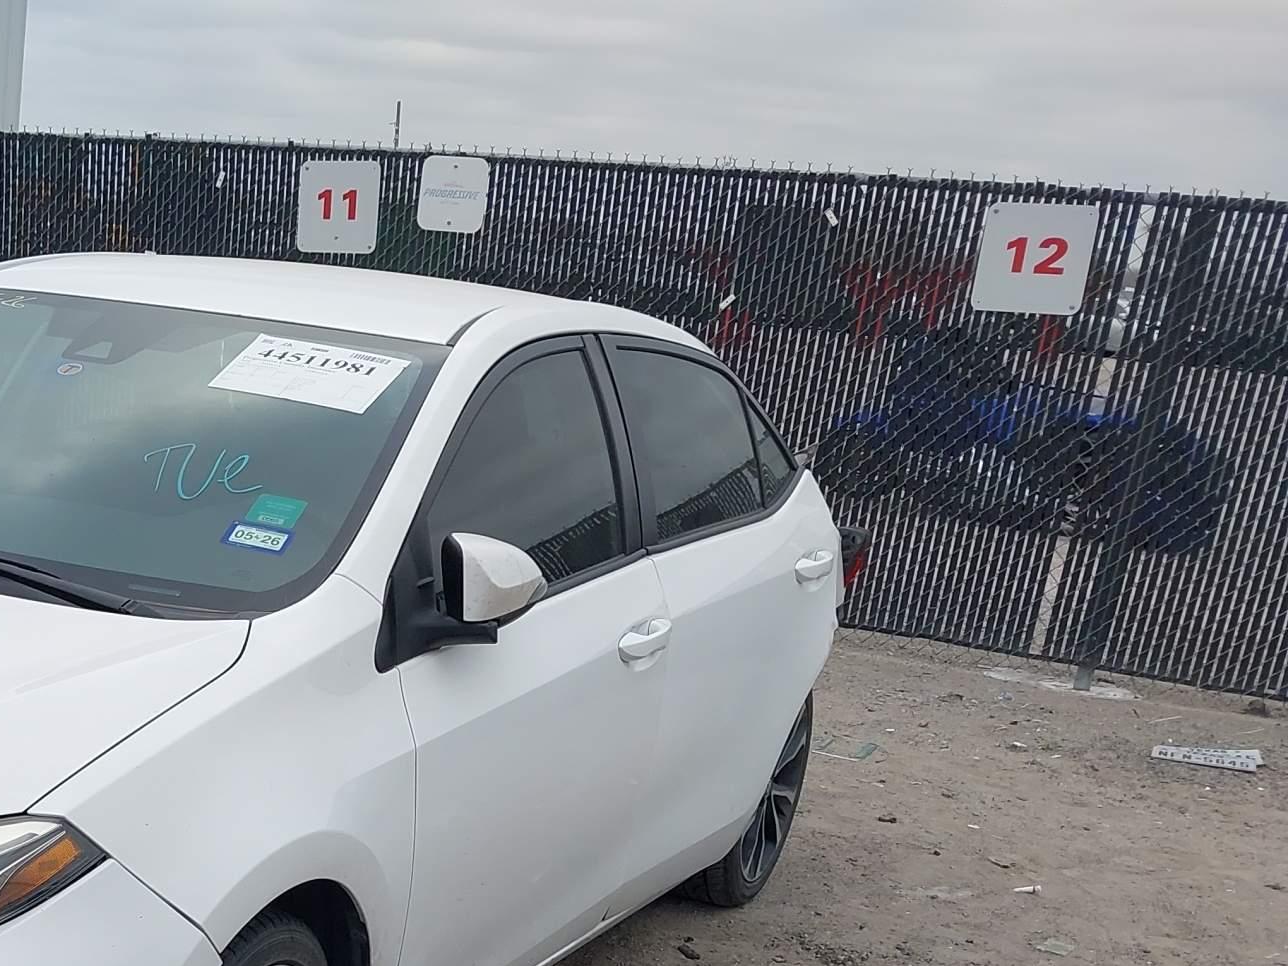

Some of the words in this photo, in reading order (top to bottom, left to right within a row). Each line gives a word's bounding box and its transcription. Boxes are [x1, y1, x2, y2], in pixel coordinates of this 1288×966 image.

[317, 189, 358, 220] 11
[423, 188, 480, 201] PROGRESSIVE
[1006, 237, 1069, 275] 12
[257, 349, 378, 376] 44511981
